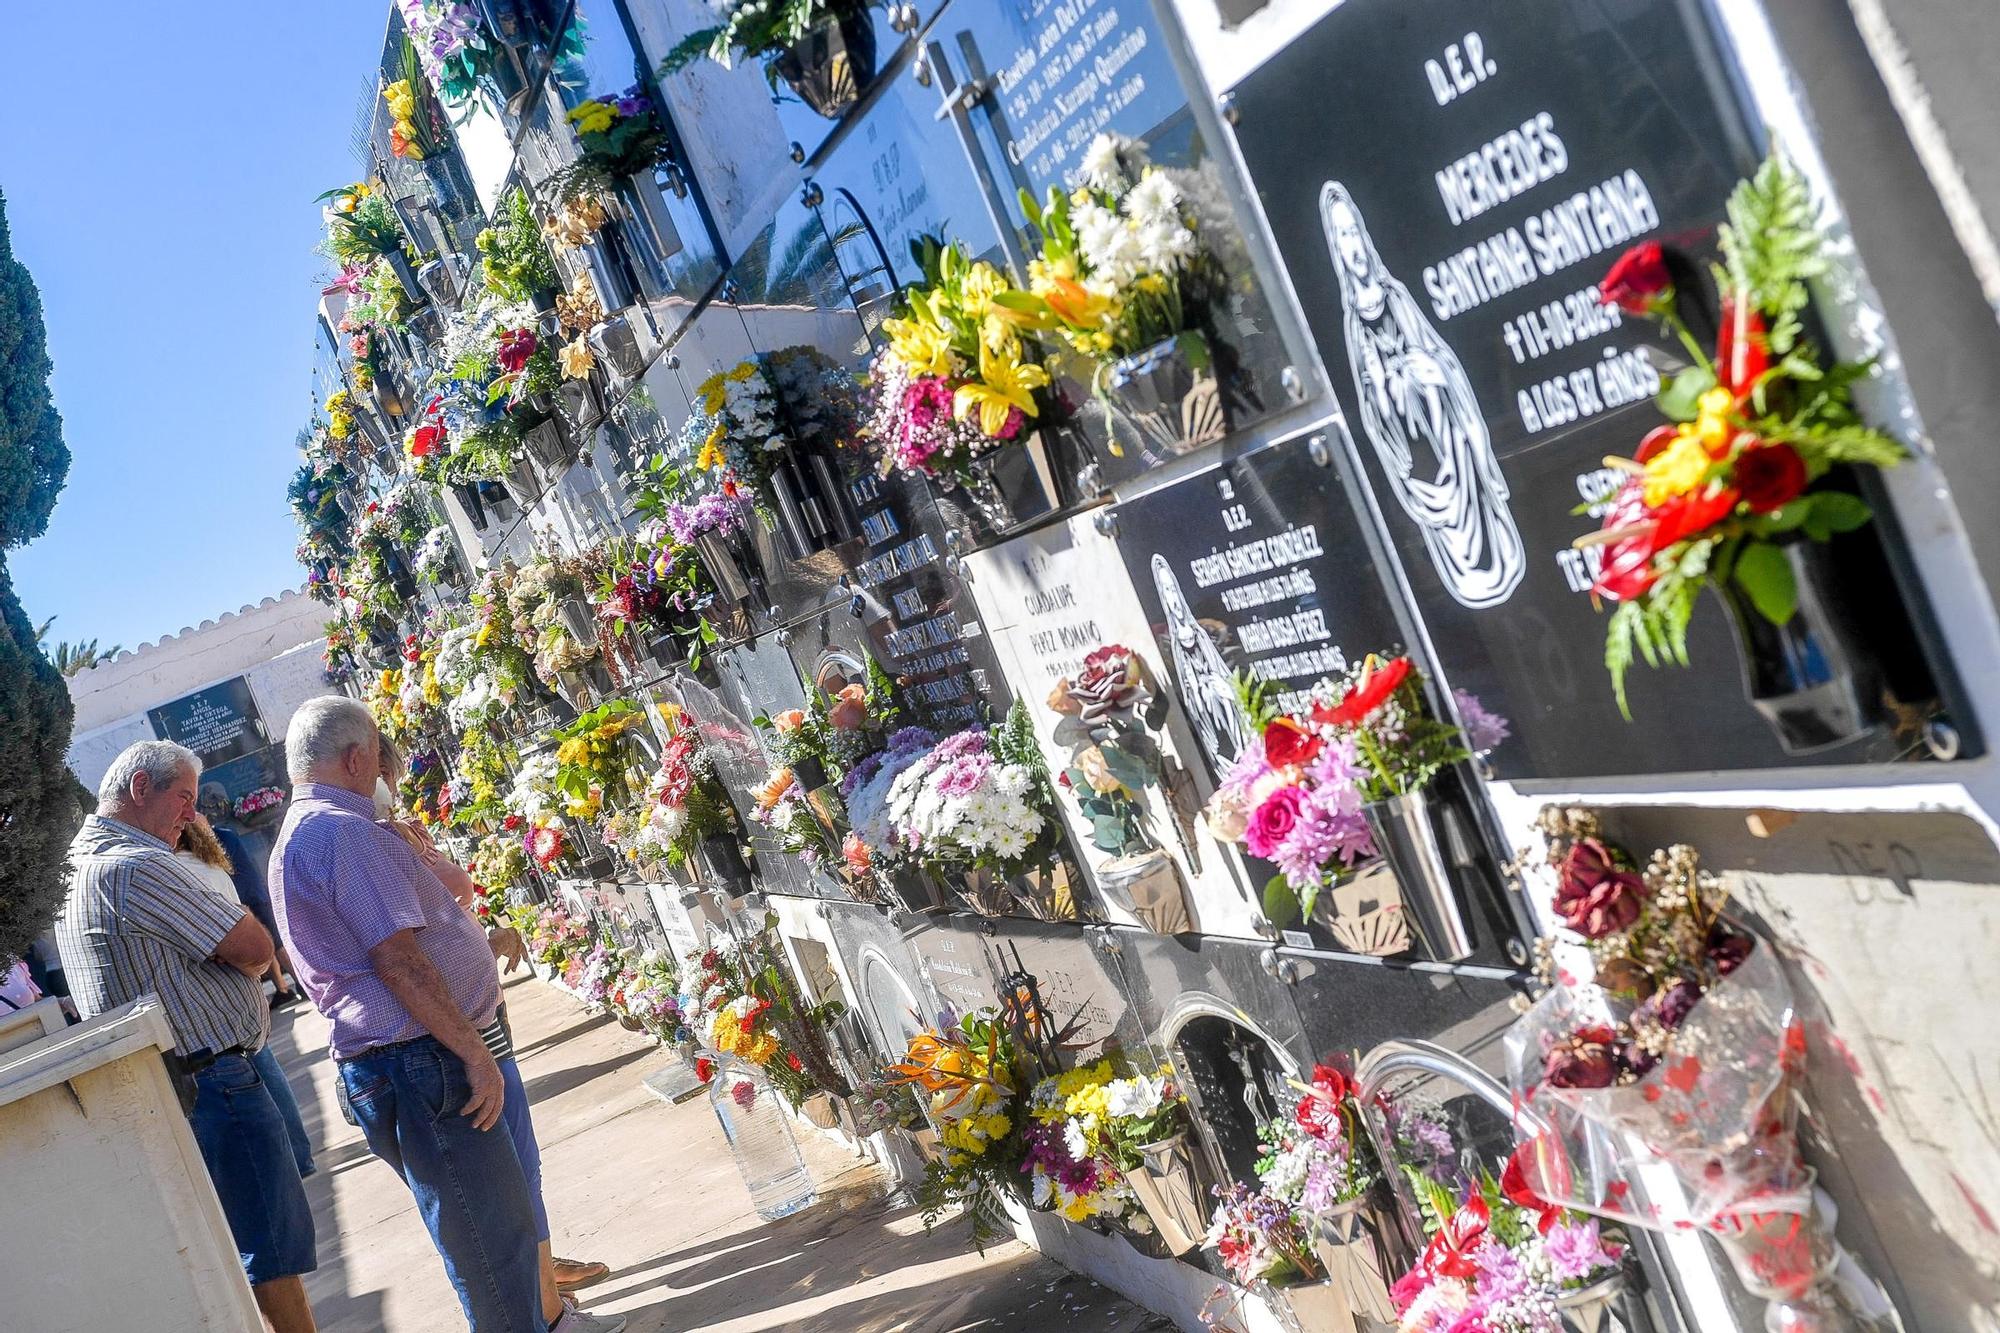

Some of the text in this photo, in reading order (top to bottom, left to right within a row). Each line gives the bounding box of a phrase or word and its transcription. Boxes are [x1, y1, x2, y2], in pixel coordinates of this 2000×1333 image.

[1424, 31, 1498, 106] D.E.P.
[1435, 111, 1568, 226] MERCEDES
[1423, 168, 1660, 321] SANTANA SANTANA
[1518, 389, 1543, 433] A
[1531, 376, 1578, 428] LOS
[1596, 346, 1660, 408] AÑOS
[1225, 541, 1274, 579] SÁNCHEZ
[1266, 522, 1324, 568] GONZÁLEZ
[1237, 615, 1274, 654] MARÍA
[1291, 605, 1332, 643] PÉREZ
